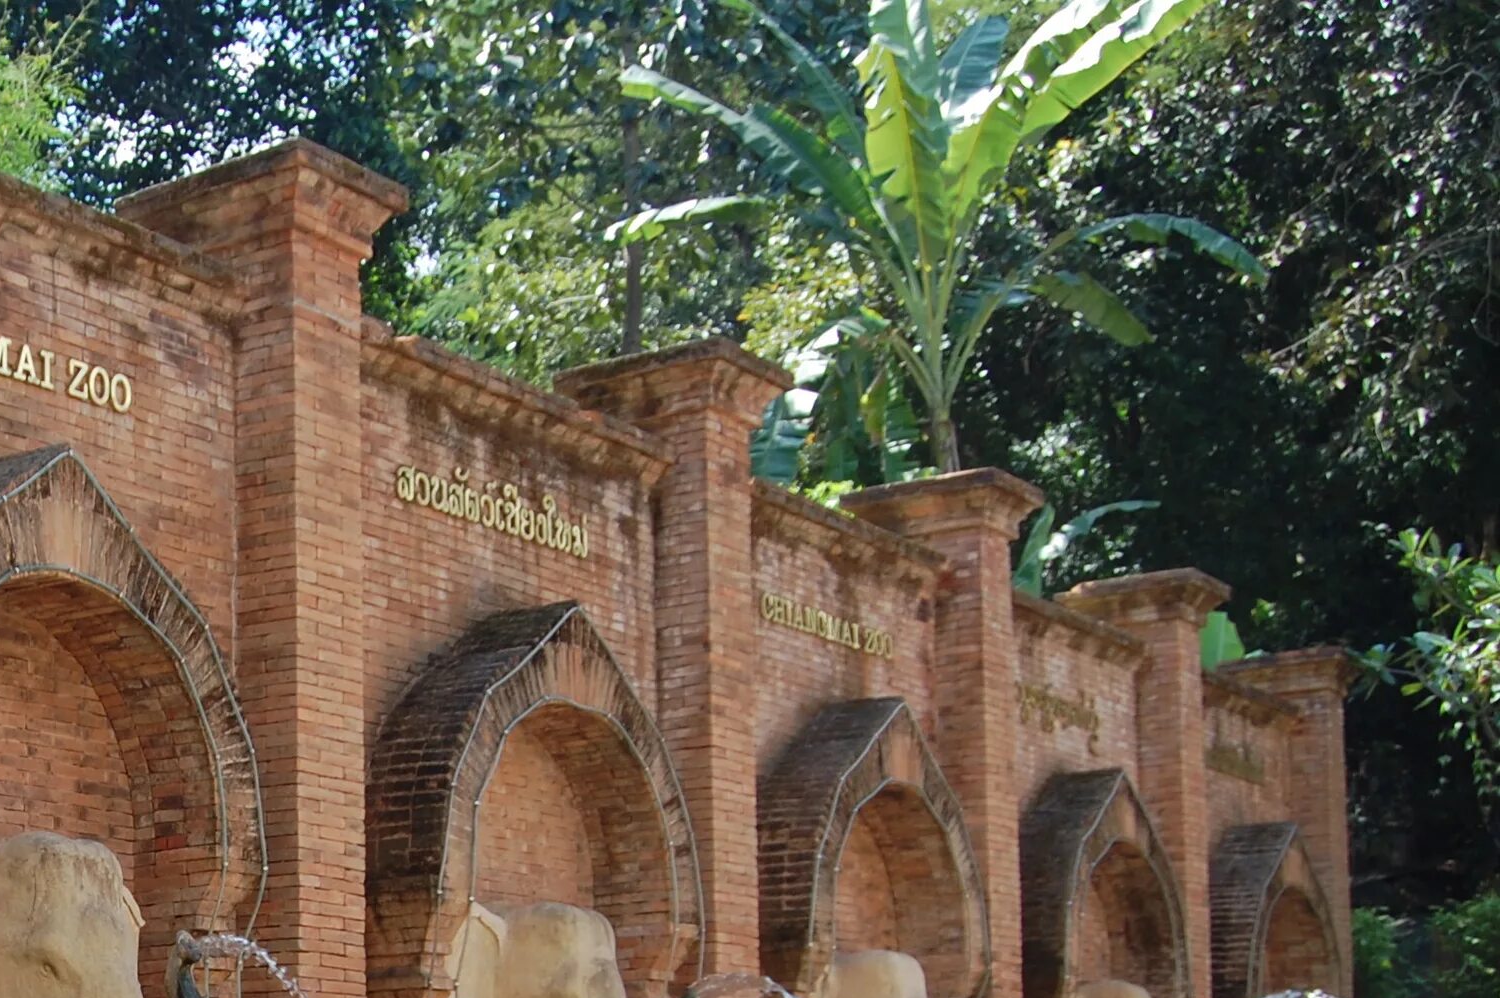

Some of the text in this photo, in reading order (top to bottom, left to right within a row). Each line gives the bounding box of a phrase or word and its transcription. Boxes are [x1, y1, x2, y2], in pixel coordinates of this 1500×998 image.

[66, 357, 132, 413] ZOO
[396, 464, 589, 559] สวนสัตว์เชียงใหม่
[761, 592, 894, 660] CHIANGMAI ZOO
